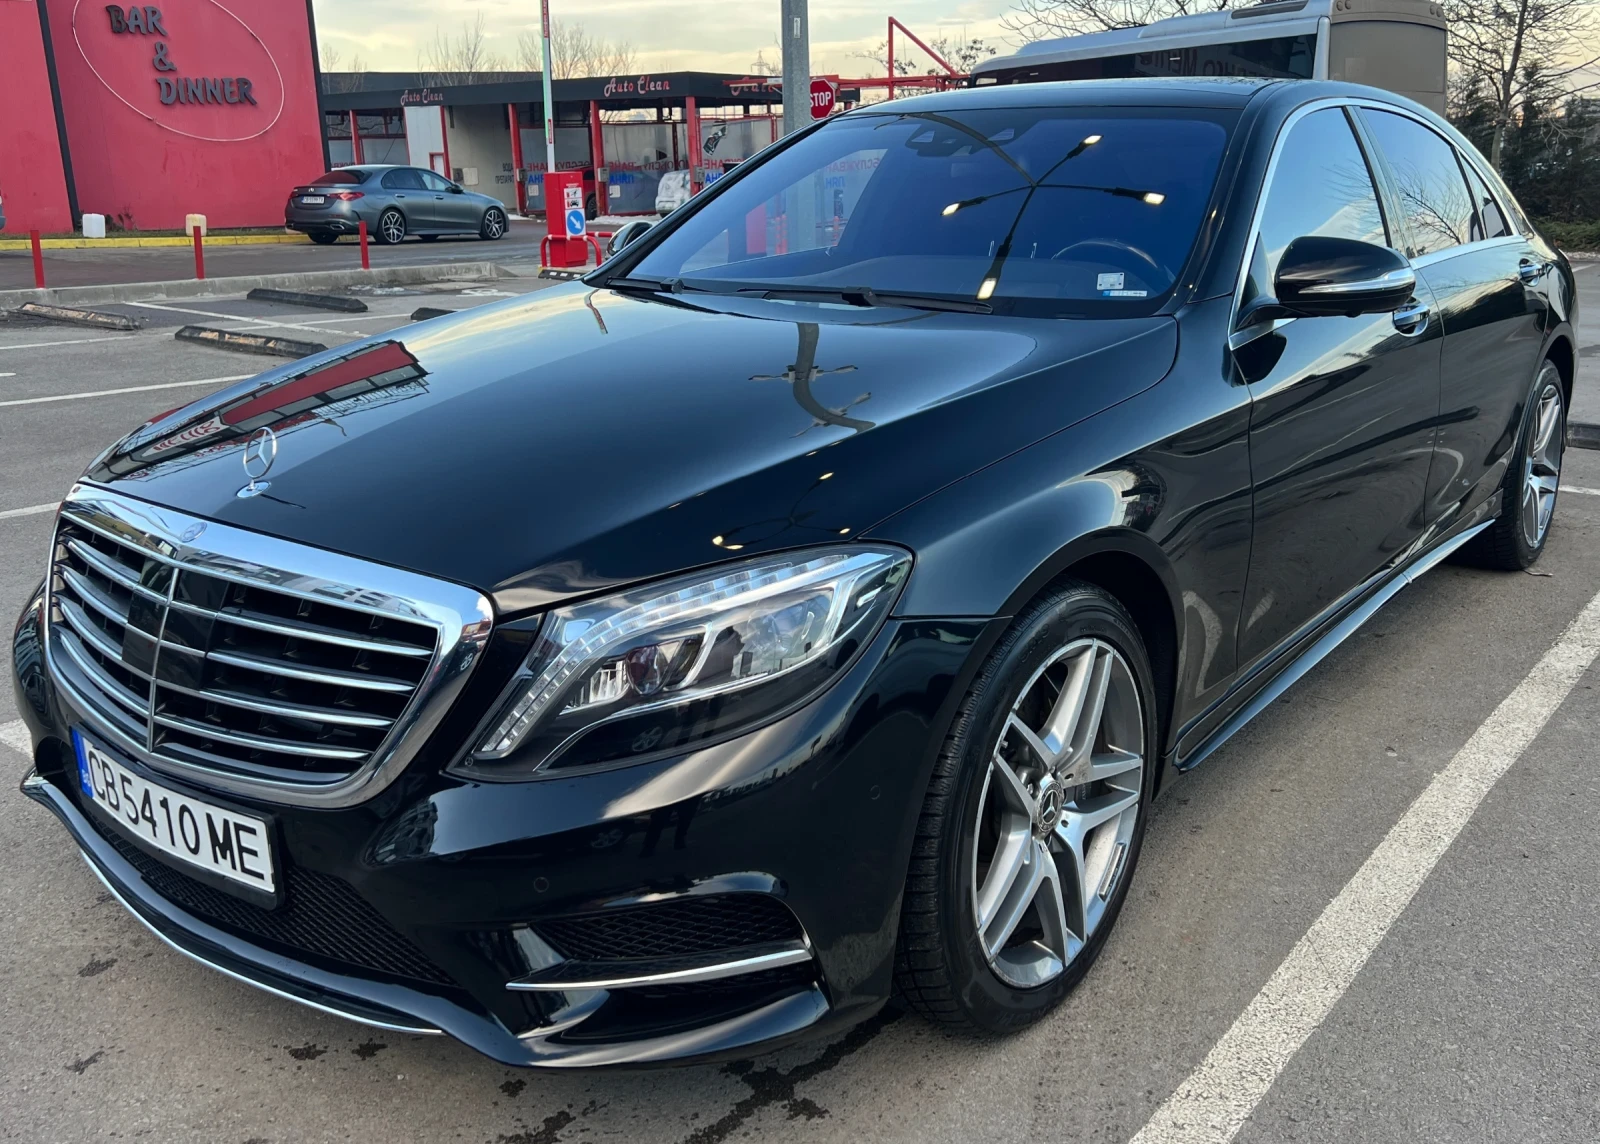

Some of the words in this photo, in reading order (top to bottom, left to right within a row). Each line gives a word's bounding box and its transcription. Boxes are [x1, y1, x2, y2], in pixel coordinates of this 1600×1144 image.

[105, 5, 168, 36] BAR
[153, 41, 177, 71] &
[156, 77, 258, 106] DINNER
[400, 90, 420, 106] Auto
[422, 88, 444, 103] Clean
[604, 77, 634, 97] Auto
[637, 75, 670, 94] Clean
